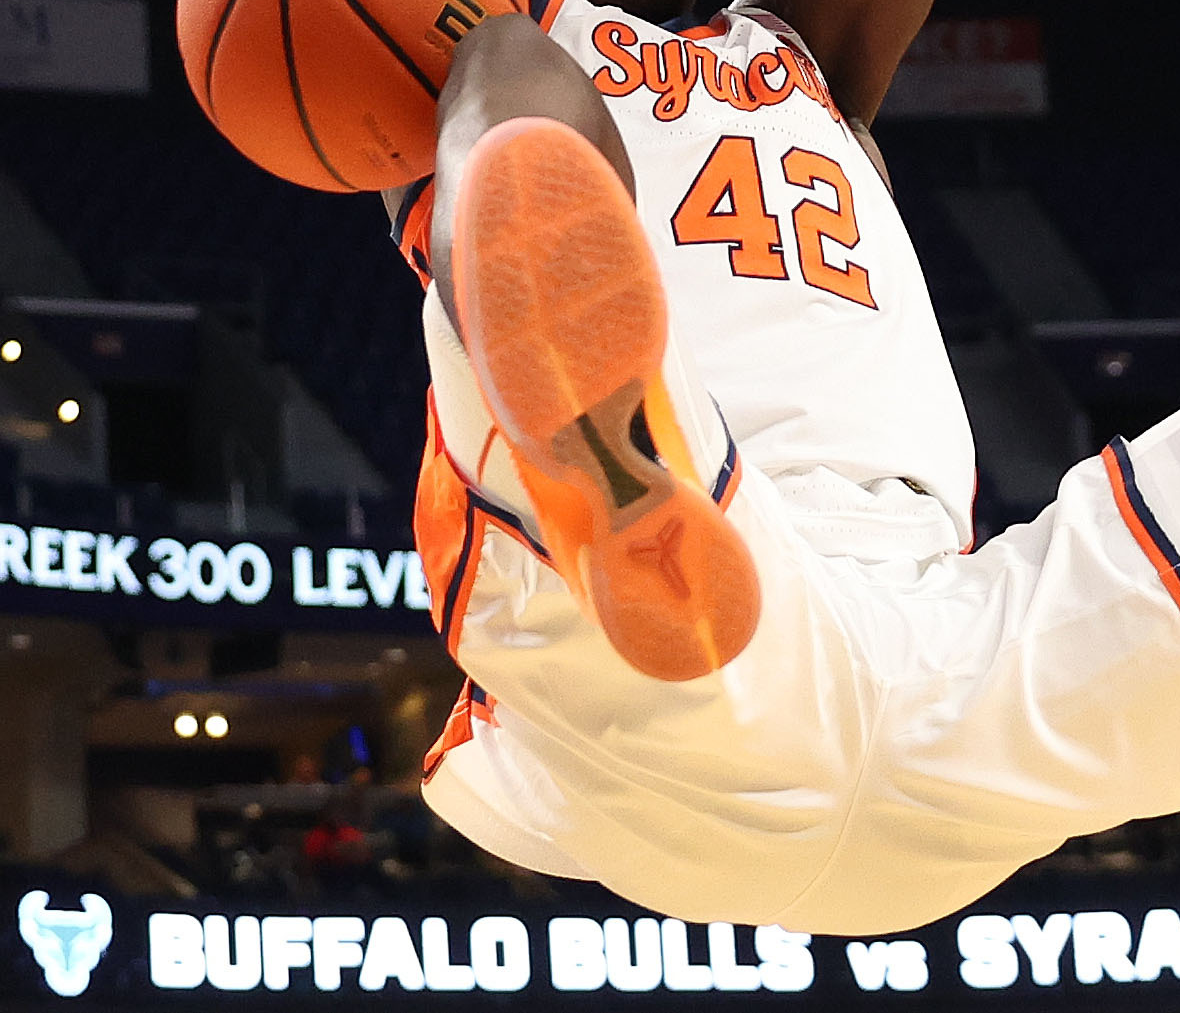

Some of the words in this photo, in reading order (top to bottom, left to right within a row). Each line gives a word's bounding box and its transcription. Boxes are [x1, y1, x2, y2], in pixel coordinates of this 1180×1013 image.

[670, 134, 879, 311] 42
[0, 523, 141, 595] REEK
[147, 537, 273, 604] 300
[148, 912, 531, 992] BUFFALO
[548, 915, 815, 992] BULLS
